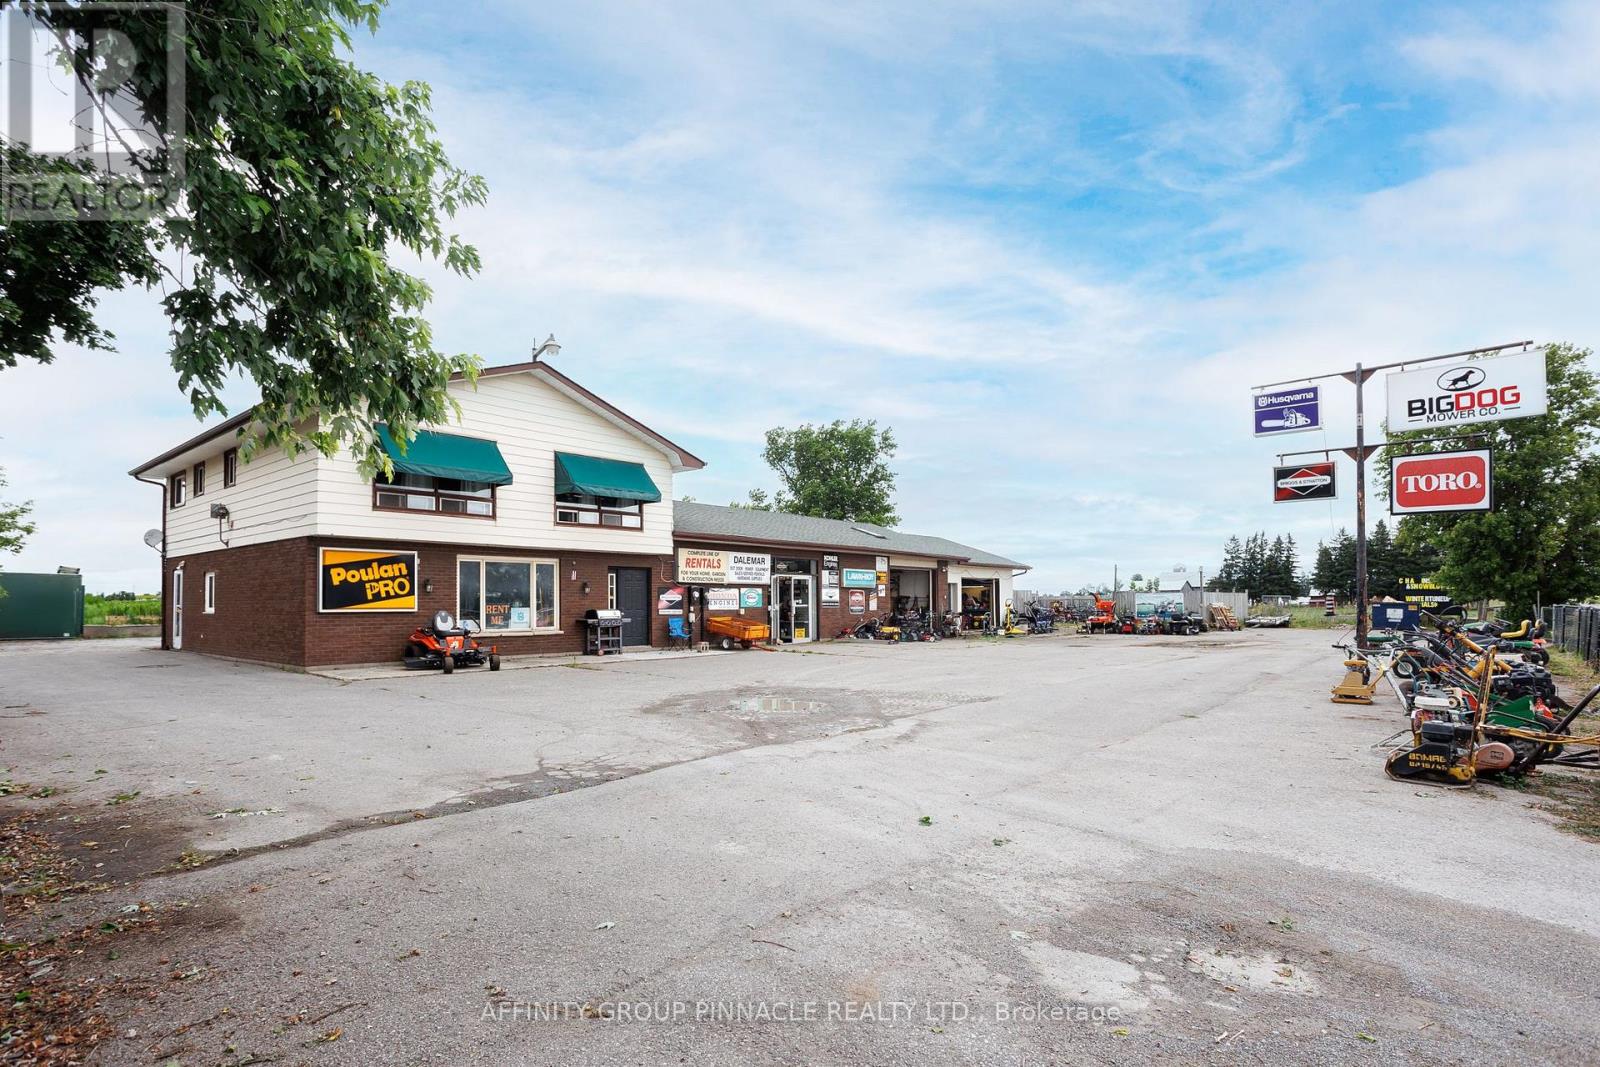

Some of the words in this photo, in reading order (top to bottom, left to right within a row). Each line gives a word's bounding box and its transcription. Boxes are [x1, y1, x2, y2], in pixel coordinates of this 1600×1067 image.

[1267, 392, 1314, 405] Husqvarna
[1426, 409, 1476, 423] MOWER
[1479, 406, 1501, 416] CO.
[1303, 477, 1328, 485] STRATTON
[685, 557, 722, 569] RENTALS
[733, 556, 766, 565] DALEMAR
[330, 562, 408, 586] Poulan
[365, 577, 410, 600] PRO
[485, 604, 510, 614] RENT
[490, 615, 504, 624] ME
